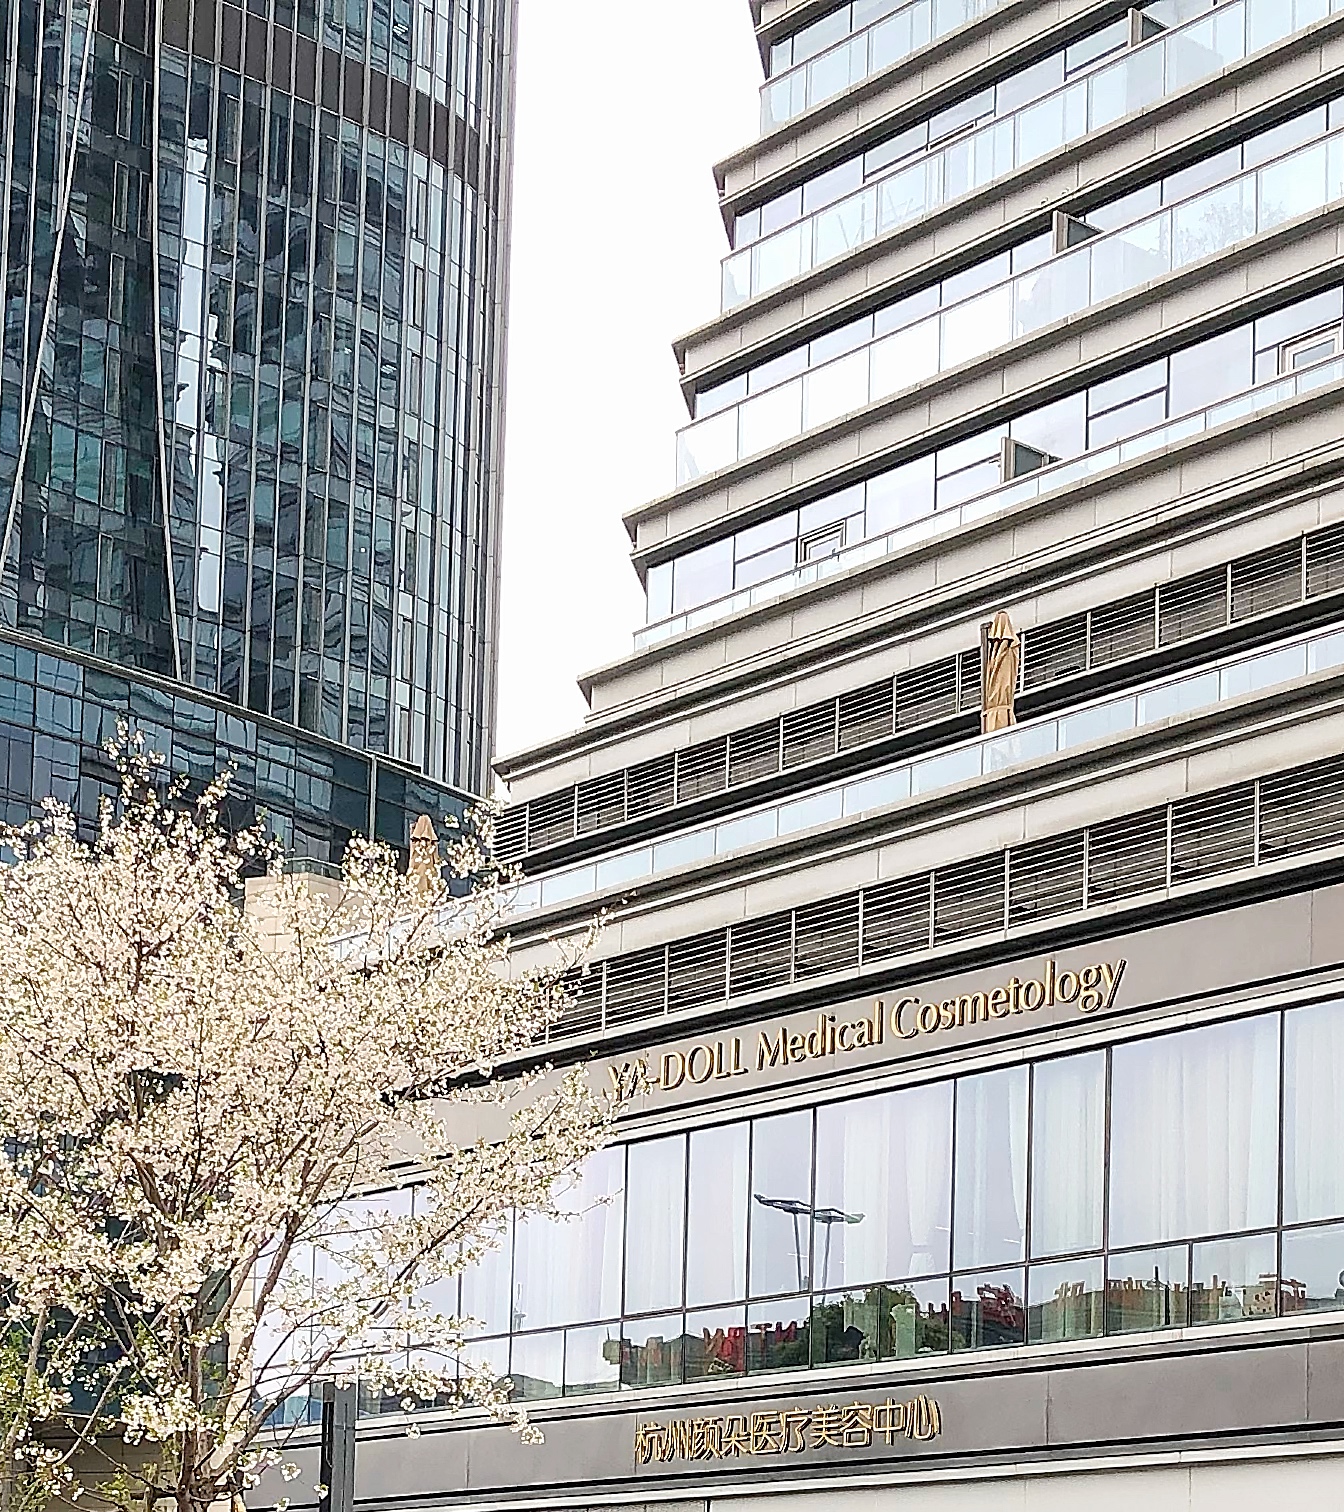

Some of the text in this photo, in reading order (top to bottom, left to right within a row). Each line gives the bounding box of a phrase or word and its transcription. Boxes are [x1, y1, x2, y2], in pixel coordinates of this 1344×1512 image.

[608, 958, 1127, 1100] YA-DOLL Medical Cosmetology
[635, 1395, 941, 1463] 杭州颜朵医疗美容中心
